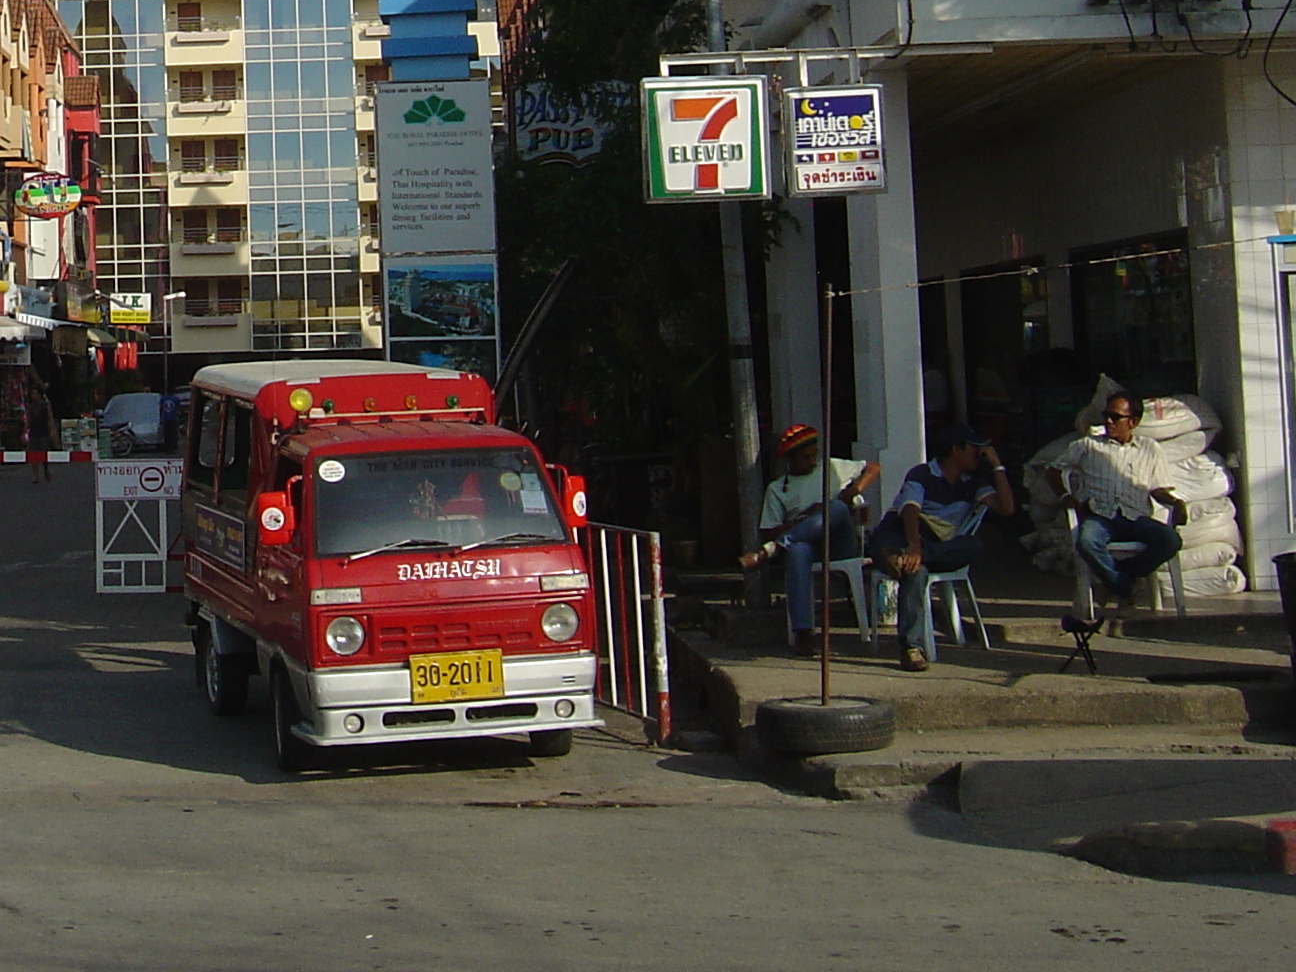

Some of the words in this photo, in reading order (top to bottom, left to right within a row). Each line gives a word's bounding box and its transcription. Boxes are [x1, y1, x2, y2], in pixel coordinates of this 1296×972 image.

[527, 127, 594, 151] PUB
[671, 97, 739, 190] 7
[431, 168, 439, 176] of
[411, 180, 453, 188] Hospitality
[455, 202, 480, 211] superb
[392, 214, 416, 222] dining
[97, 465, 140, 476] ทางออก
[123, 486, 138, 495] EXIT
[163, 486, 174, 495] NO
[397, 559, 501, 580] DAIHATSU
[416, 660, 493, 687] 30-2011
